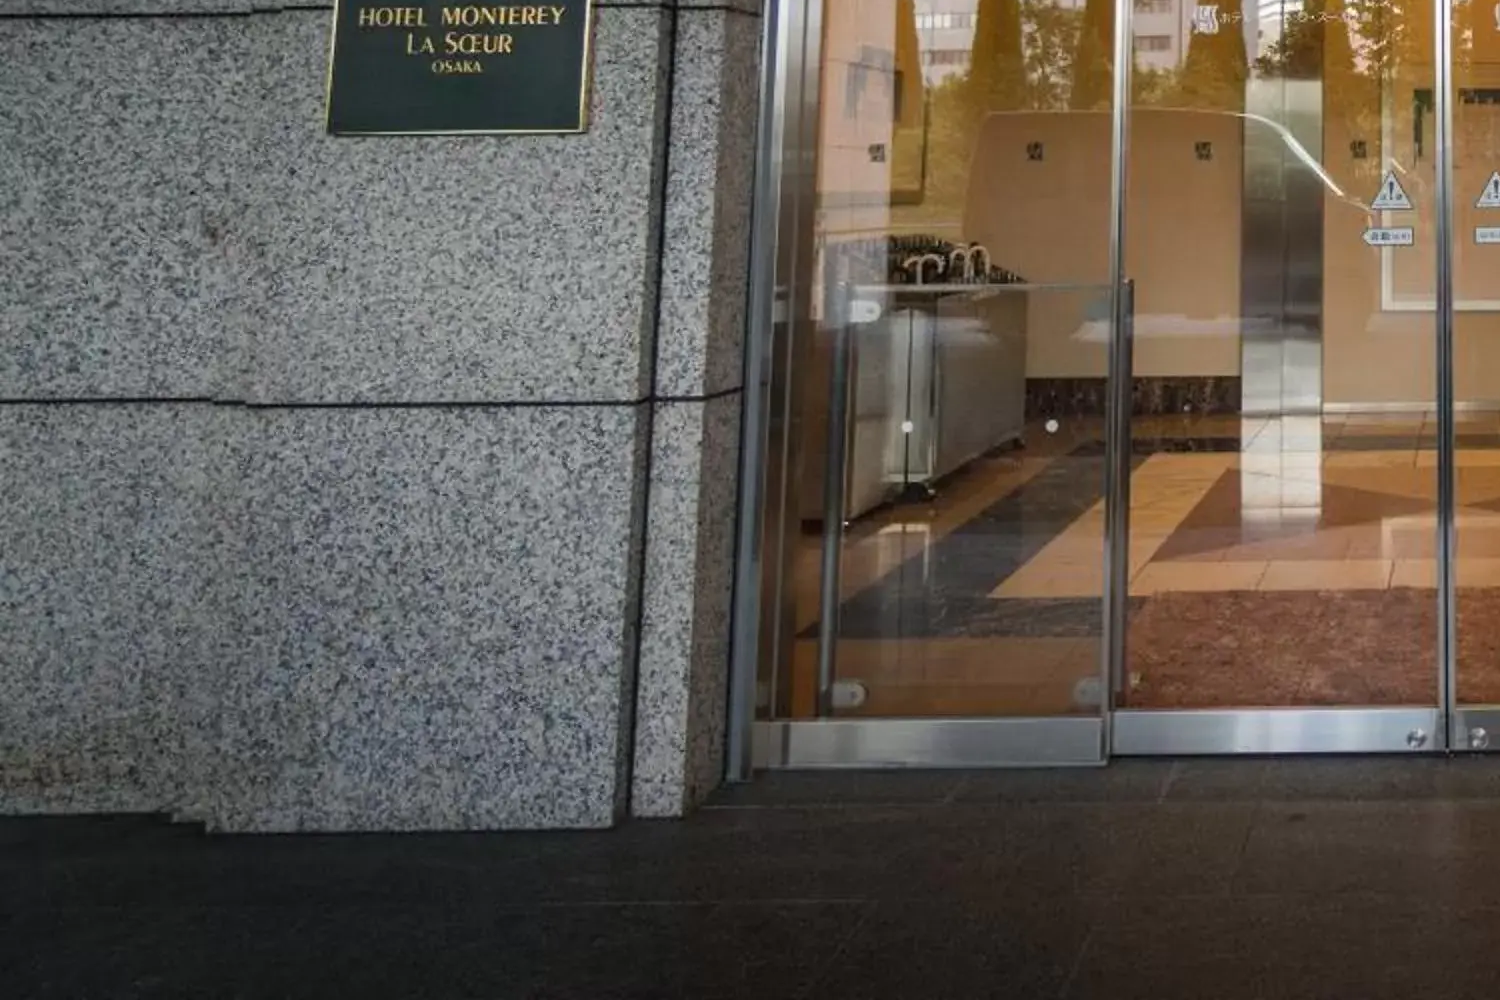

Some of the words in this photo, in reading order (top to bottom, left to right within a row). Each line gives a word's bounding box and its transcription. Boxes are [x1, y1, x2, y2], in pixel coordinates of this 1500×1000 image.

[358, 7, 428, 27] HOTEL
[441, 5, 566, 27] MONTEREY
[406, 33, 435, 55] LA
[431, 59, 483, 74] OSAKA
